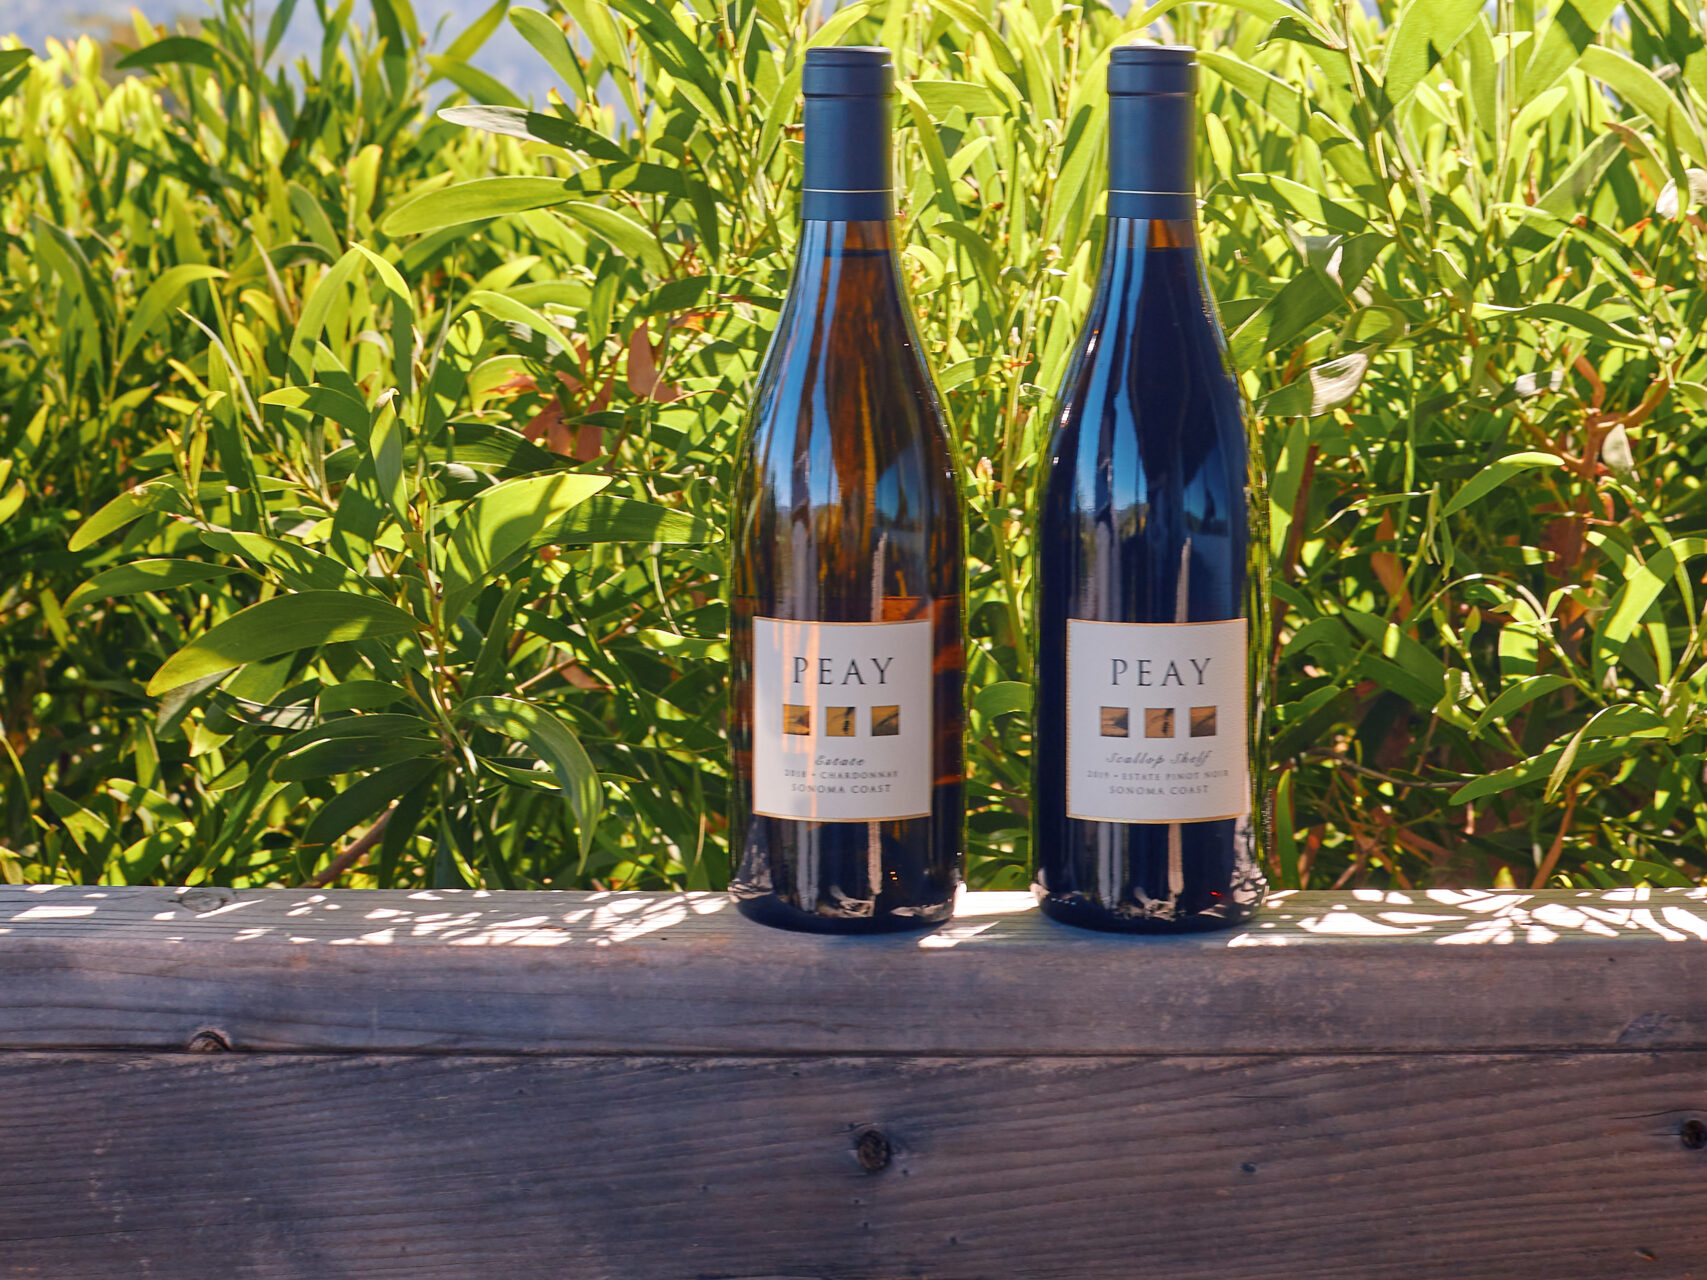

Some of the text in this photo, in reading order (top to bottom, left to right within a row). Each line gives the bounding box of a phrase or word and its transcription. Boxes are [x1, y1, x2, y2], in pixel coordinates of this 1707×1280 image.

[793, 656, 894, 685] PEAY
[1112, 658, 1212, 686] PEAY
[815, 755, 866, 766] Estate
[1106, 751, 1212, 768] Scallop Shelf
[1121, 772, 1160, 781] ESTATE
[1166, 772, 1199, 780] PINOT
[1204, 770, 1228, 778] NOIR
[791, 783, 892, 793] SONOMA COAST
[1109, 785, 1209, 795] SONOMA COAST
